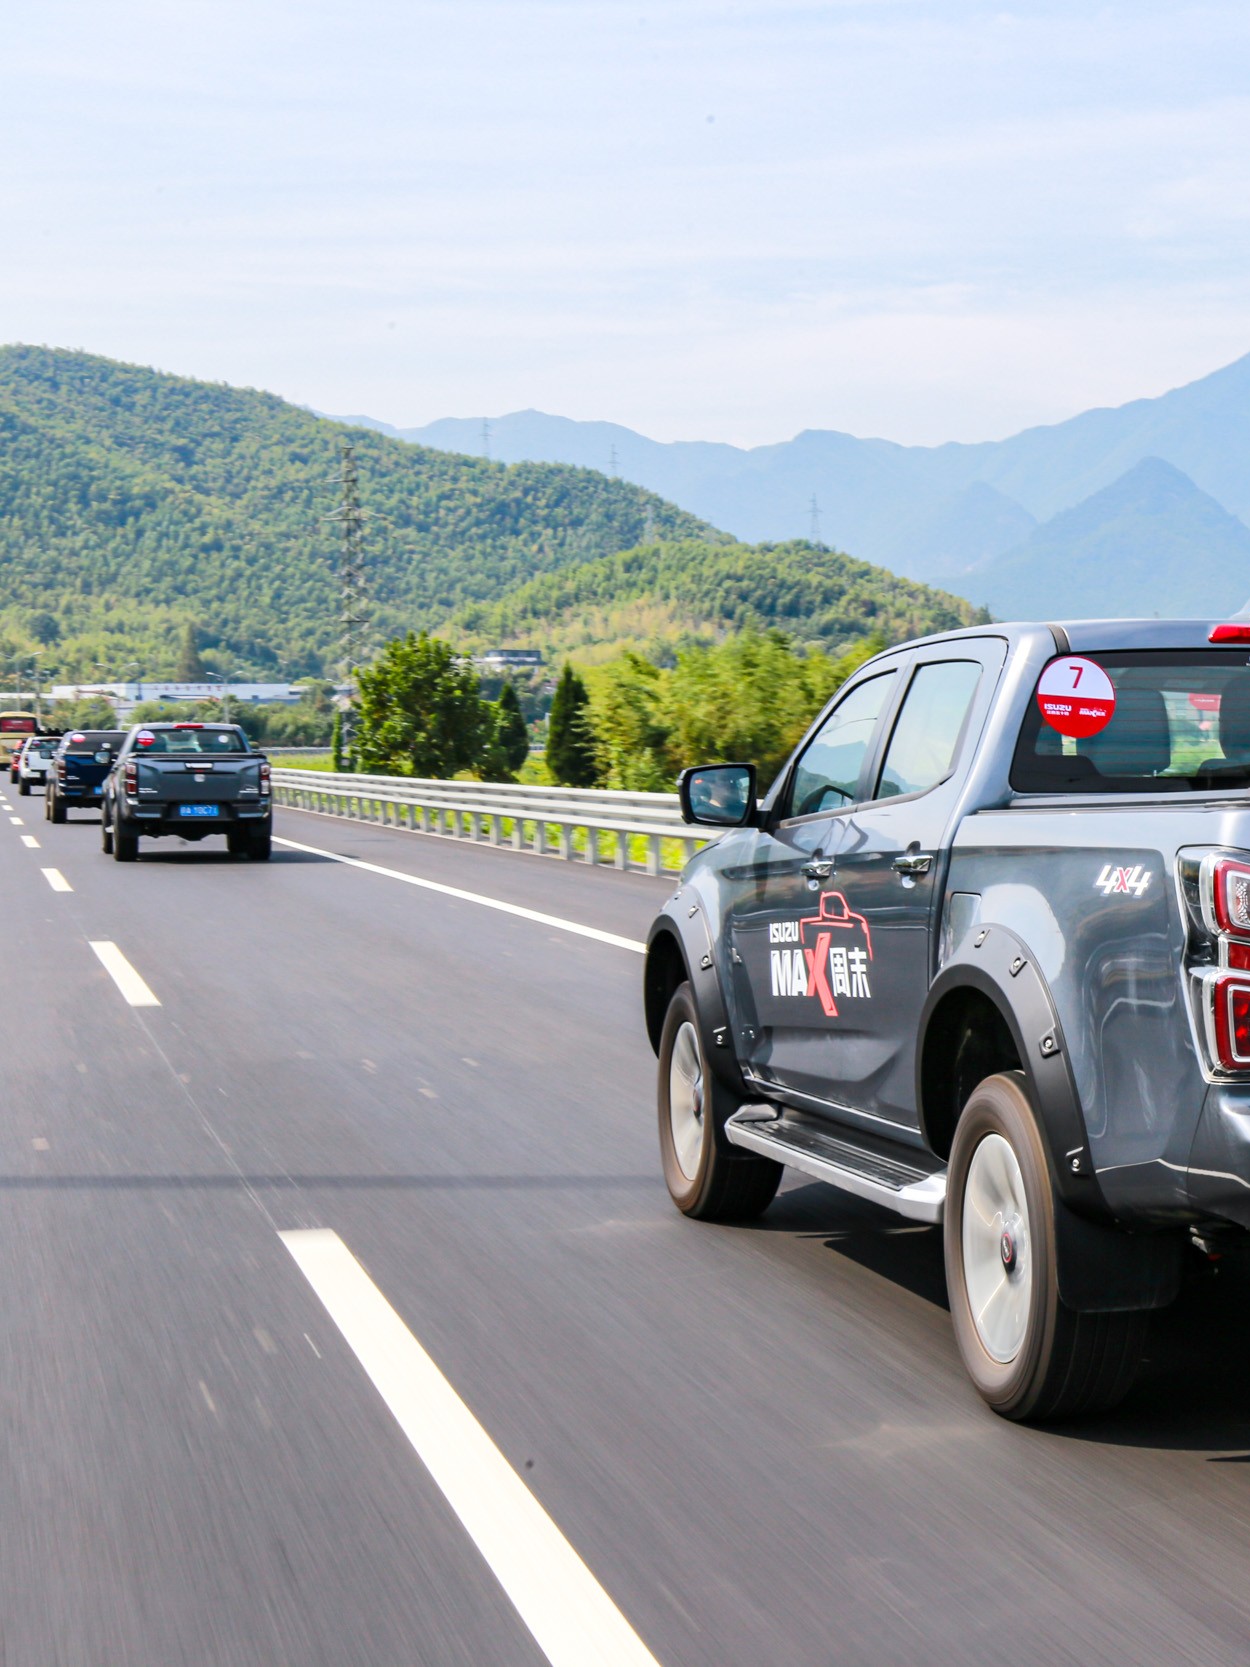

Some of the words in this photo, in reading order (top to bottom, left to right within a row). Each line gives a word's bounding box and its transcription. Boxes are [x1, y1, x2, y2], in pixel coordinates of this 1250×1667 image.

[1069, 665, 1084, 689] 7
[1044, 703, 1072, 711] ISUZU
[769, 921, 799, 943] ISUZU
